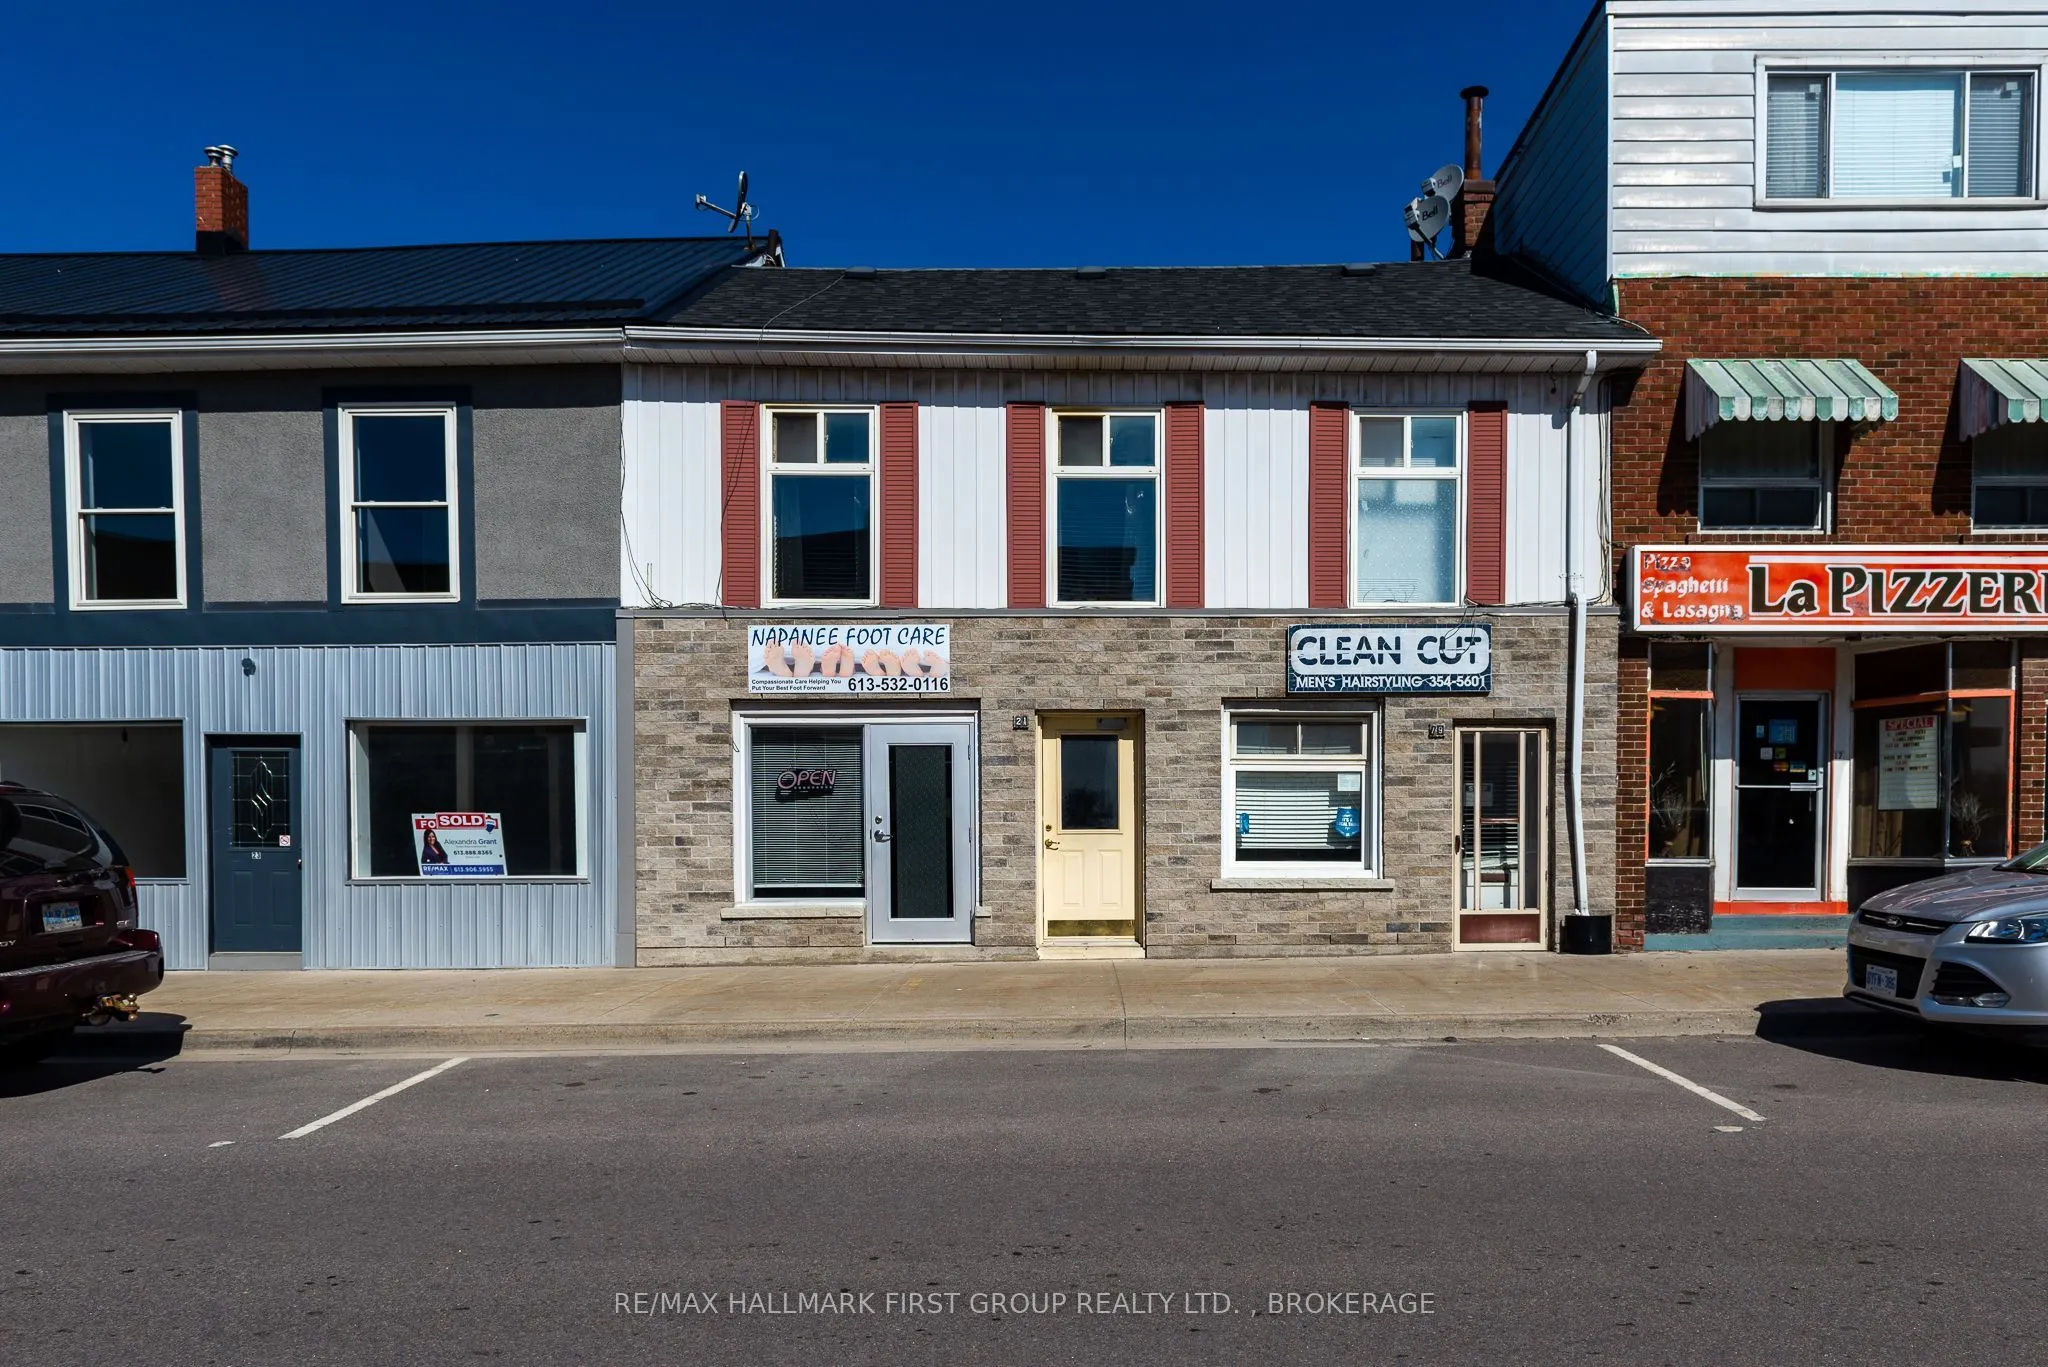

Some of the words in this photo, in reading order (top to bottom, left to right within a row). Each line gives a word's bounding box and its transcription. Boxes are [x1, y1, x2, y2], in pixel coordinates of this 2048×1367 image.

[1422, 204, 1438, 221] Bell
[1643, 553, 1691, 571] Pizza
[1642, 576, 1729, 598] Spaghetti
[1747, 563, 1820, 617] La
[1641, 601, 1655, 618] &
[1663, 602, 1744, 622] Lasagna
[752, 627, 839, 646] NAPANEE
[846, 627, 892, 646] FOOT
[897, 627, 946, 646] CARE
[1297, 636, 1401, 665] CLEAN
[1417, 636, 1482, 665] CUT
[848, 678, 949, 692] 613-532-0116
[1297, 676, 1336, 688] MEN'S
[1342, 676, 1423, 688] HAIRSTYLING
[1429, 675, 1485, 687] 354-5601
[1016, 717, 1027, 726] 21
[1887, 717, 1932, 731] SPECIAL
[778, 770, 836, 789] OPEN
[420, 820, 436, 828] FO
[440, 815, 483, 826] SOLD
